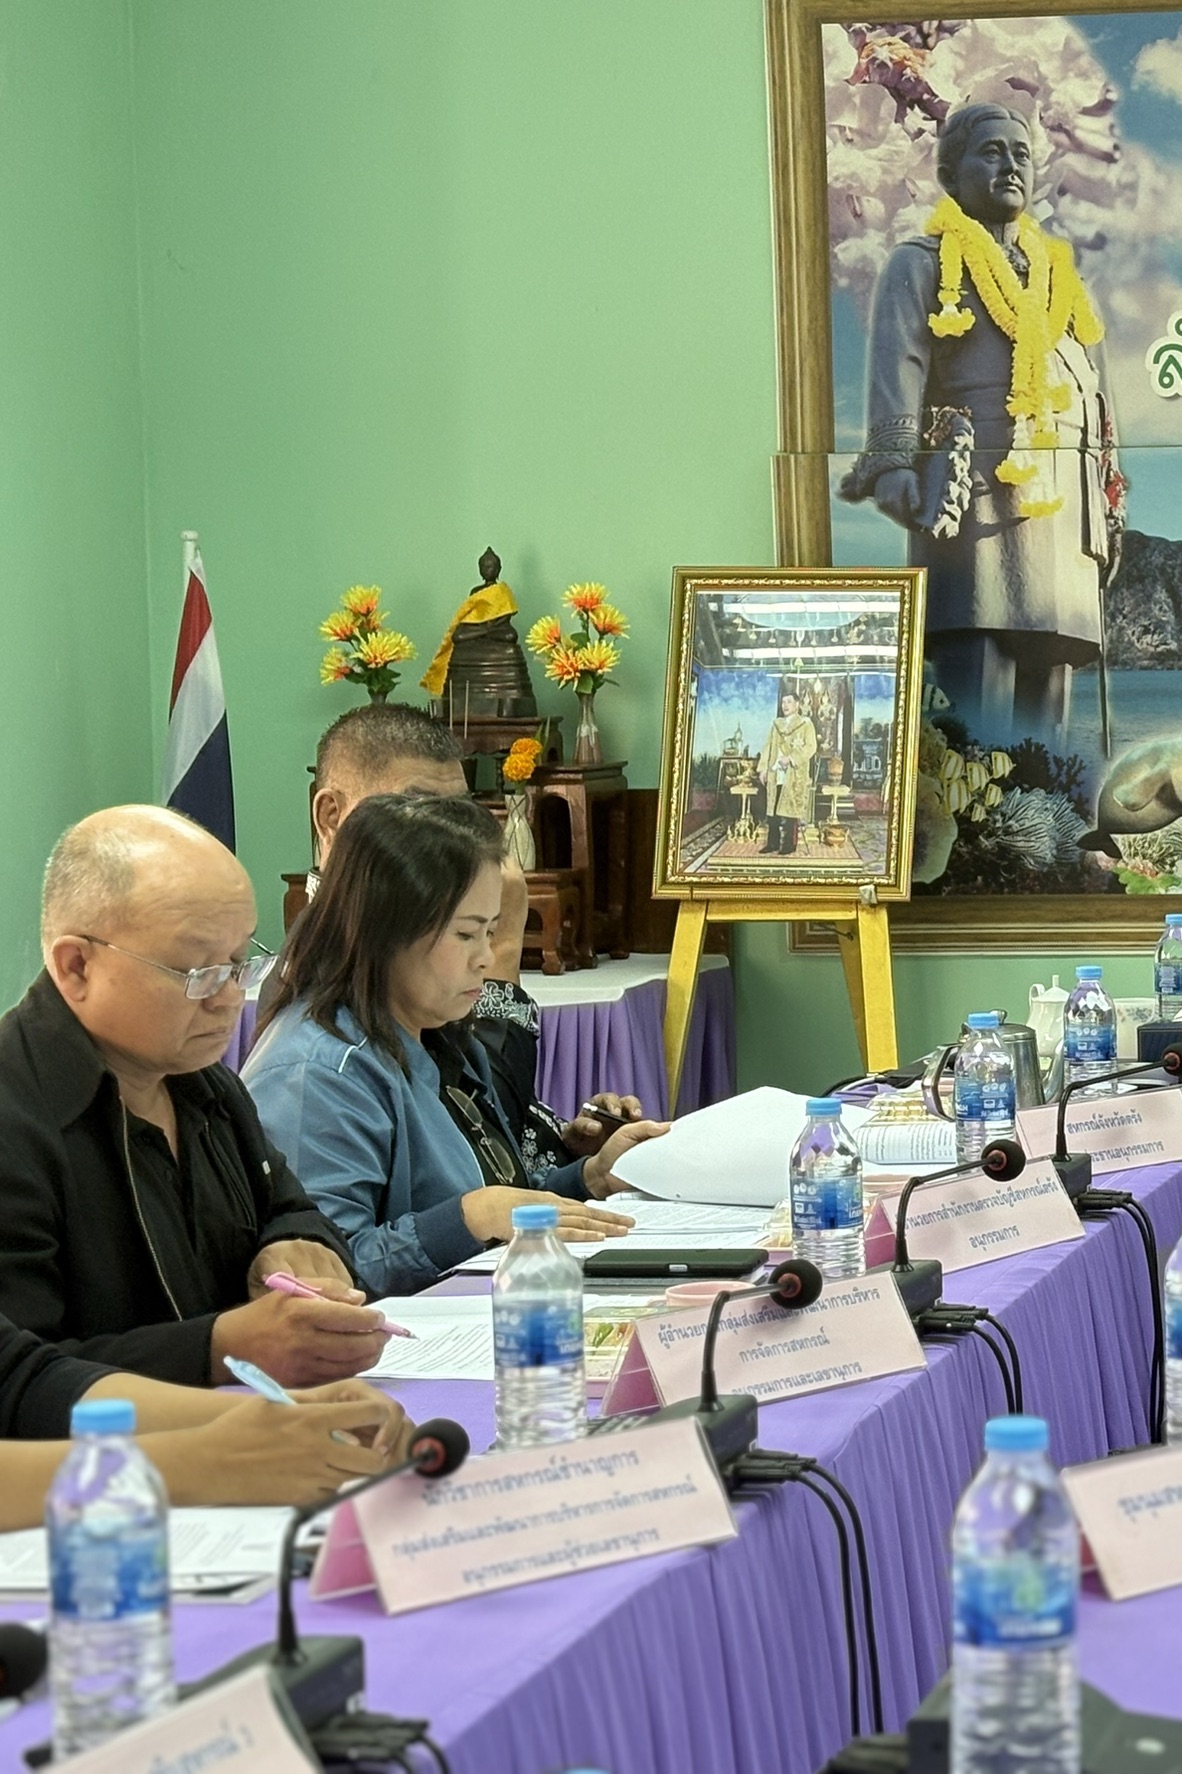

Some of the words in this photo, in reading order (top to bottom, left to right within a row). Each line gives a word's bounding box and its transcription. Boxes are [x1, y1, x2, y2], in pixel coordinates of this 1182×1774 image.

[968, 1225, 1020, 1251] อนุกรรมการ
[738, 1326, 831, 1364] การจัดการสหกรณ์
[731, 1361, 864, 1397] อนกรรมการและเลขานุการ
